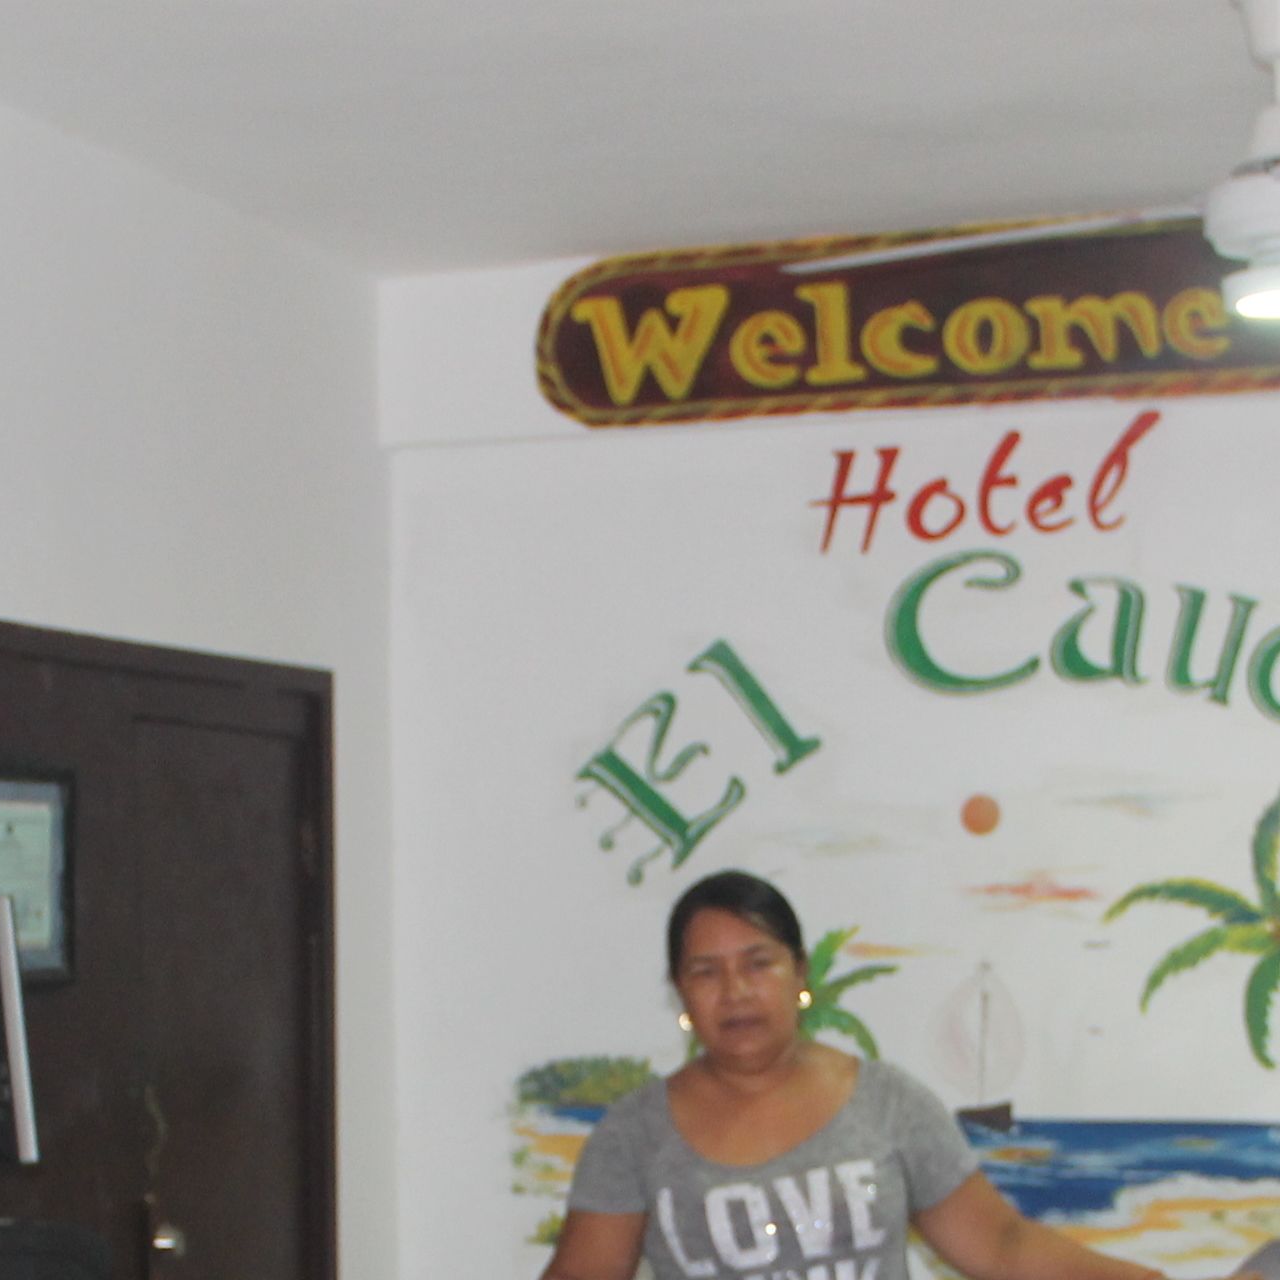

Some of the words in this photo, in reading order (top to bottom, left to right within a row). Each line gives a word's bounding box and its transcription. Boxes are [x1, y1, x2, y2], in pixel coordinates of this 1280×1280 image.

[573, 281, 1231, 405] Welcome
[808, 410, 1161, 554] Hotel
[575, 638, 821, 887] El
[656, 1158, 887, 1278] LOVE
